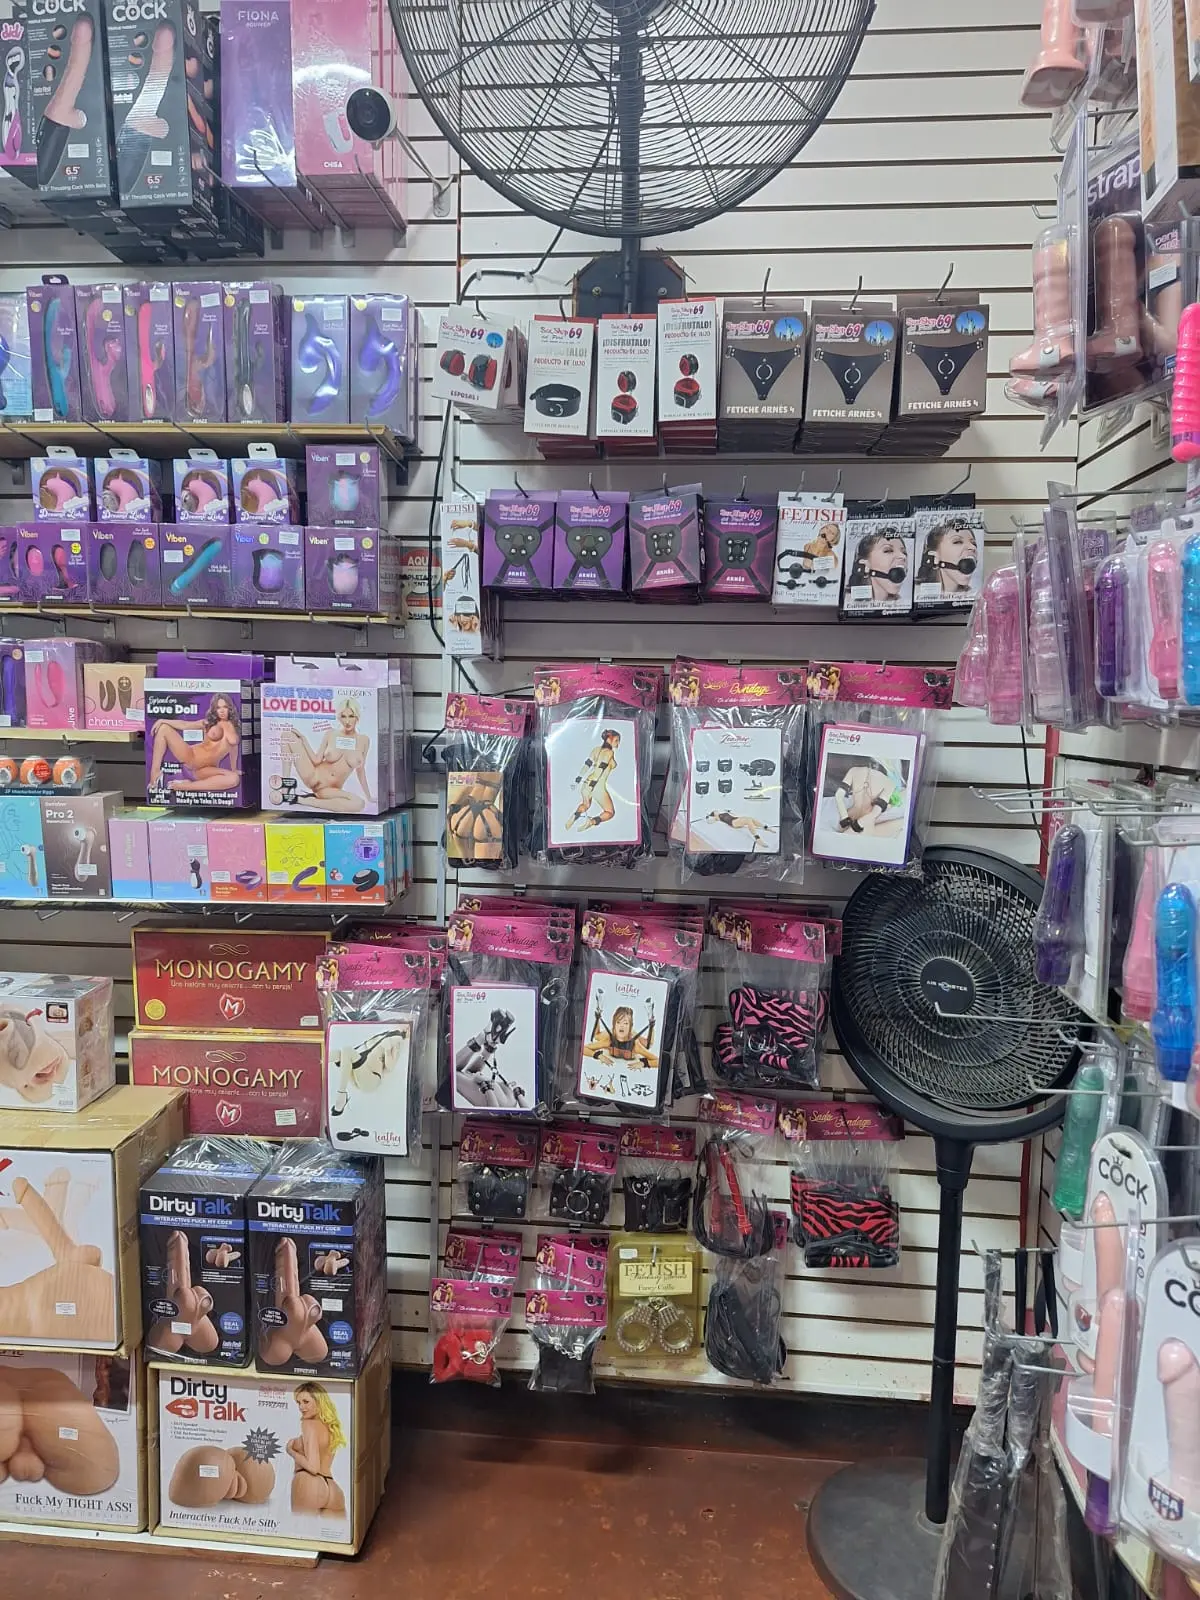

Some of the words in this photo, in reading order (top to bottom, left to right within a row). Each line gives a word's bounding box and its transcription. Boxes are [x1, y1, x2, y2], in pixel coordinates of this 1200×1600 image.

[32, 0, 87, 16] COCK
[113, 1, 168, 22] COCK
[237, 10, 280, 21] FIONA
[470, 327, 484, 339] 69
[569, 327, 583, 339] 69
[726, 405, 760, 414] FETICHE
[908, 401, 942, 410] FETICHE
[812, 409, 847, 418] FETICHE
[781, 508, 844, 521] FETISH
[166, 532, 187, 543] Viben
[263, 686, 295, 699] SURE
[295, 687, 334, 700] THING
[147, 704, 174, 714] Love
[175, 704, 198, 715] Doll
[262, 699, 297, 712] LOVE
[300, 700, 336, 714] DOLL
[88, 717, 124, 727] chorus
[849, 733, 861, 744] 69
[176, 797, 193, 805] Ready
[207, 791, 226, 799] Spread
[45, 810, 65, 819] Pro
[67, 809, 74, 819] 2
[155, 958, 308, 982] MONOGAMY
[152, 1065, 304, 1089] MONOGAMY
[1098, 1156, 1149, 1205] COCK
[624, 1263, 686, 1277] FETISH
[170, 1376, 228, 1404] Dirty
[199, 1399, 247, 1423] Talk
[15, 1493, 43, 1506] Fuck
[45, 1495, 64, 1510] My
[66, 1497, 104, 1511] TIGHT
[106, 1501, 133, 1513] ASS!
[1151, 1488, 1181, 1513] USA
[169, 1510, 217, 1522] Interactive
[218, 1514, 241, 1525] Fuck
[242, 1516, 257, 1526] Me
[258, 1518, 280, 1528] Silly
